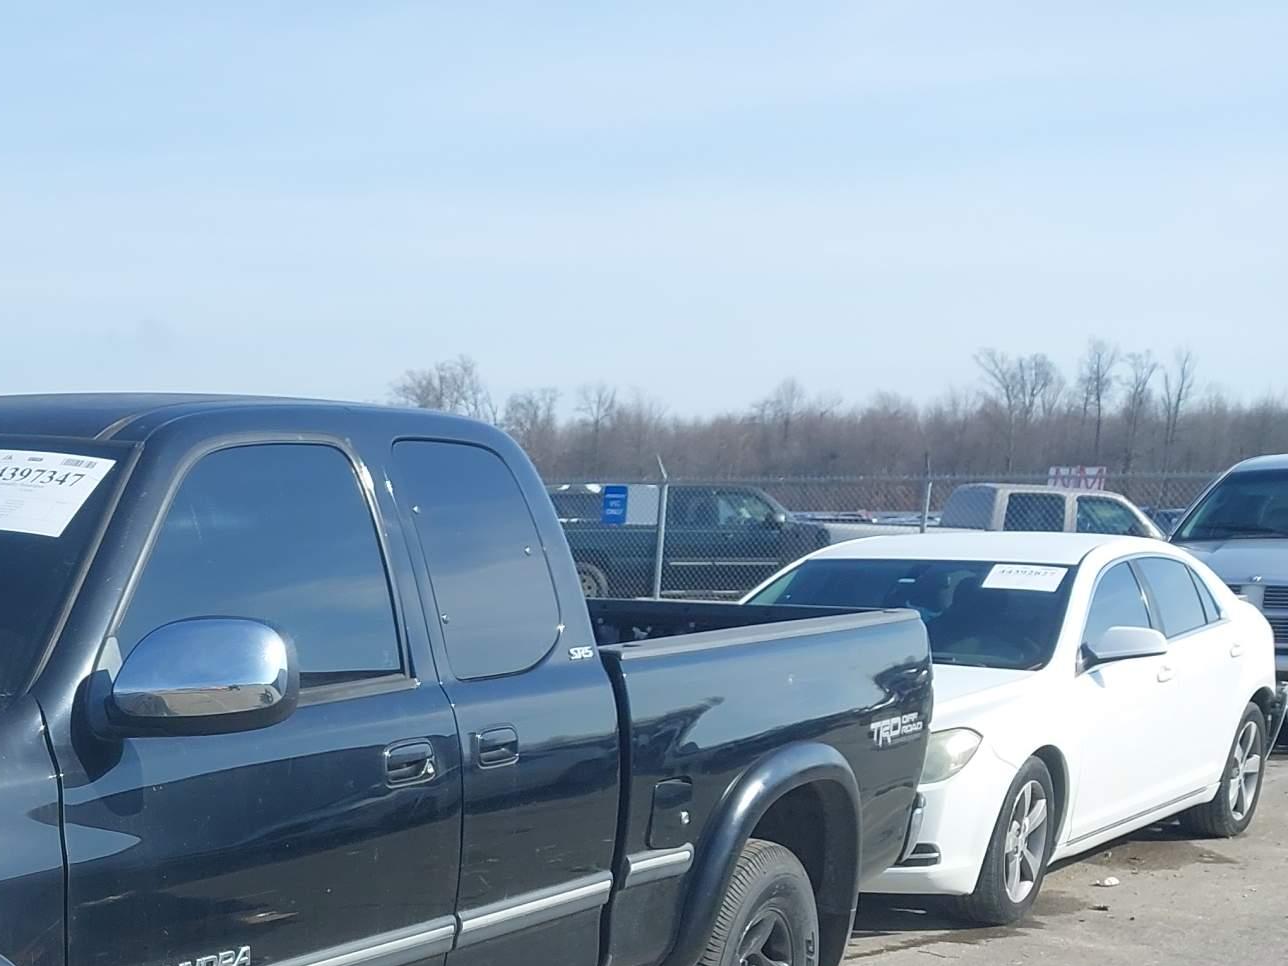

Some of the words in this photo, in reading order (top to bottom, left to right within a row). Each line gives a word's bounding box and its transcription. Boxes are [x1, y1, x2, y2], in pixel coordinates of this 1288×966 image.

[901, 712, 919, 724] OFF
[870, 716, 901, 748] TRD
[901, 721, 923, 735] ROAD
